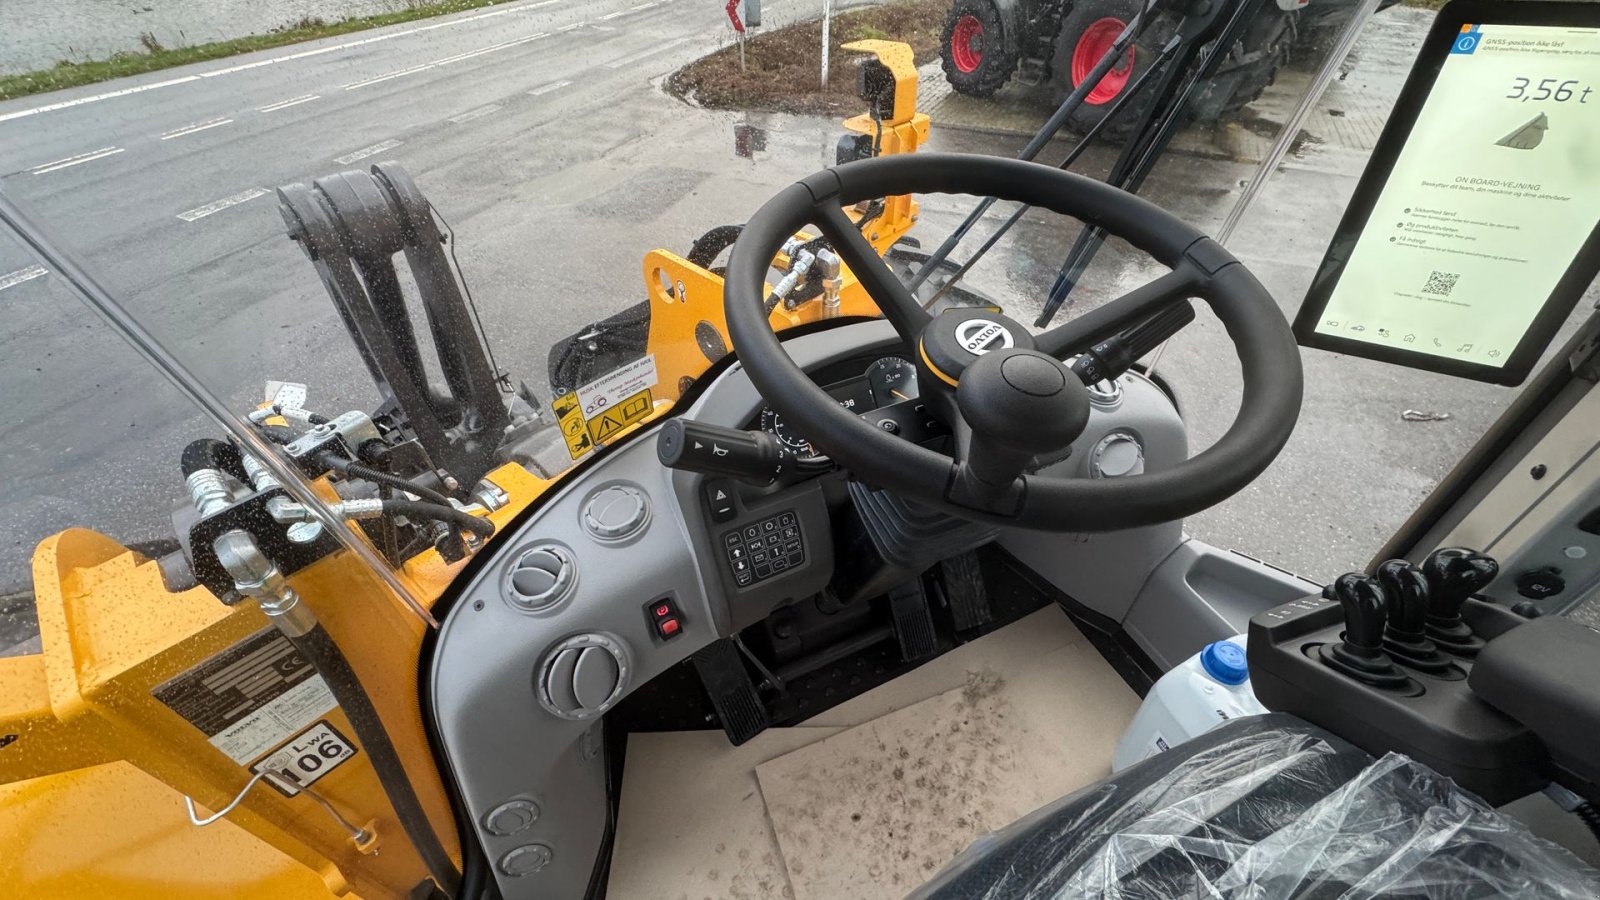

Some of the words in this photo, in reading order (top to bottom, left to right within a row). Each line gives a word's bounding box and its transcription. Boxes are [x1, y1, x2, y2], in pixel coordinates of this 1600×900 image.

[1506, 77, 1579, 103] 3,56
[1580, 86, 1592, 103] t
[1470, 177, 1541, 191] BOARD-VEJNING
[968, 325, 1002, 350] VOLVO
[282, 740, 343, 783] 106
